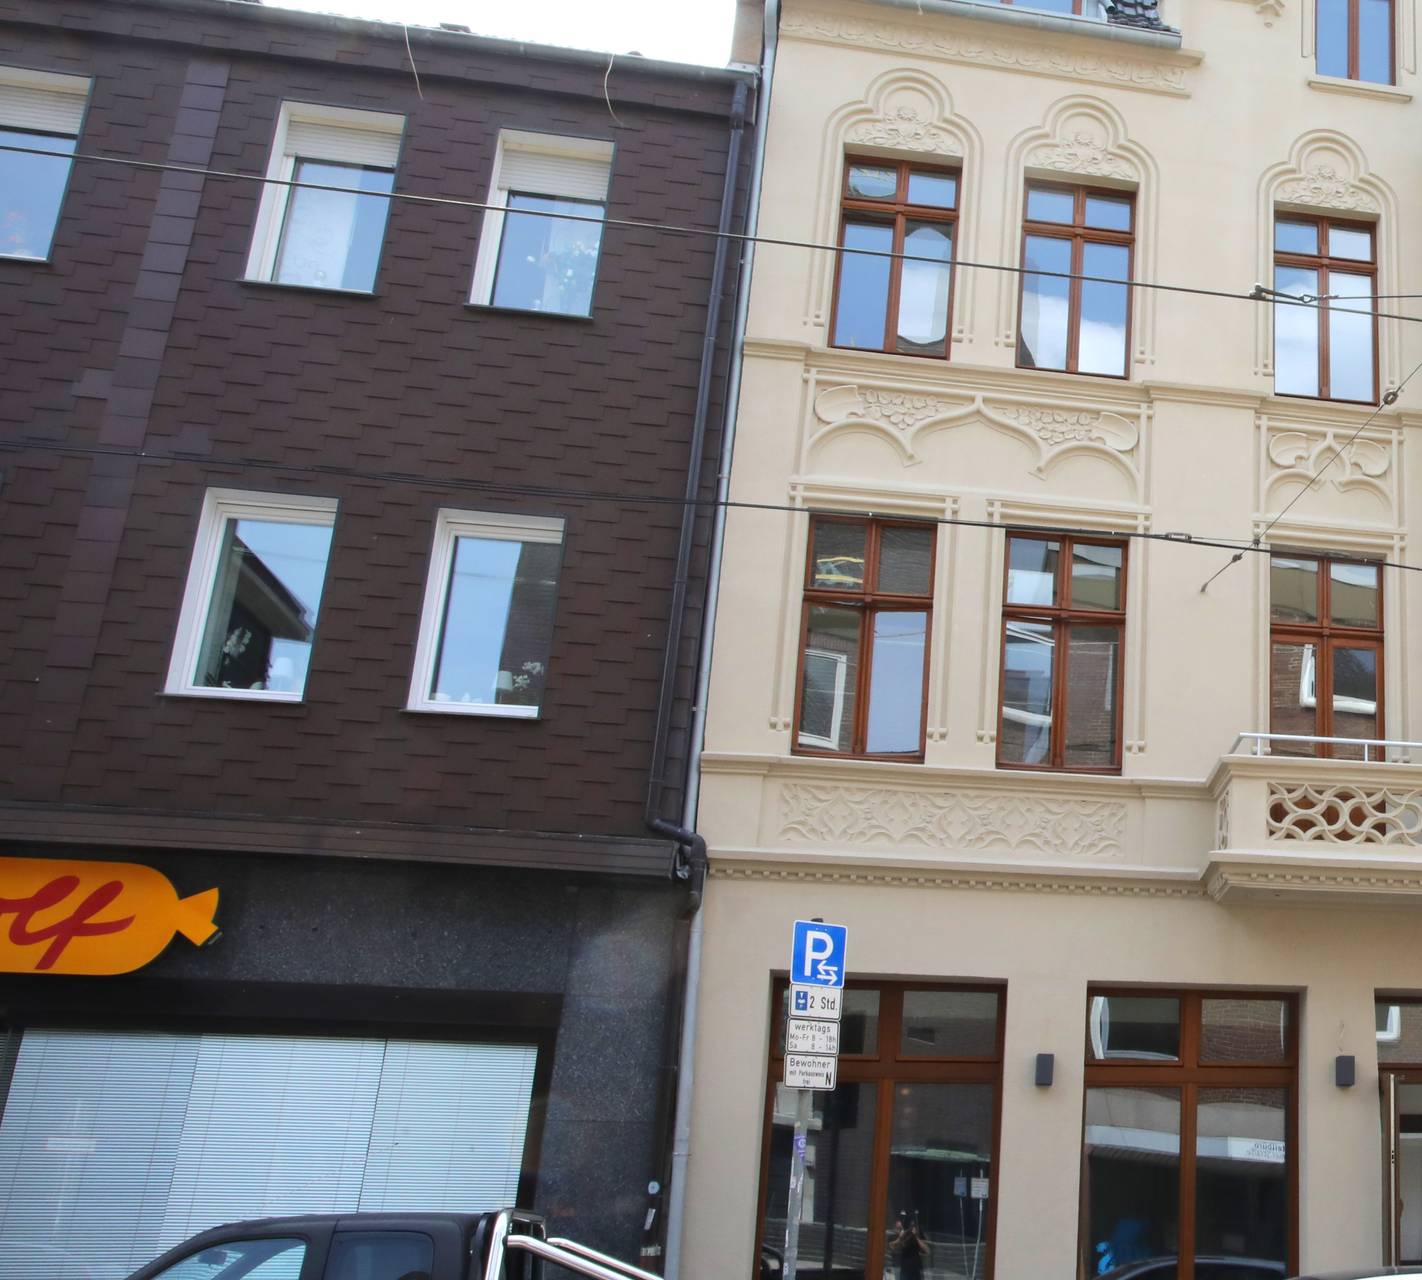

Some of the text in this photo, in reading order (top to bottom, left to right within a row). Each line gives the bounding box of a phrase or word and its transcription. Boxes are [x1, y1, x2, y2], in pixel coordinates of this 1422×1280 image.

[0, 875, 136, 970] lf
[804, 930, 834, 977] P
[810, 996, 838, 1011] 2 Std.
[795, 1024, 831, 1034] werktags
[790, 1058, 831, 1069] Bewohner
[825, 1072, 832, 1086] N
